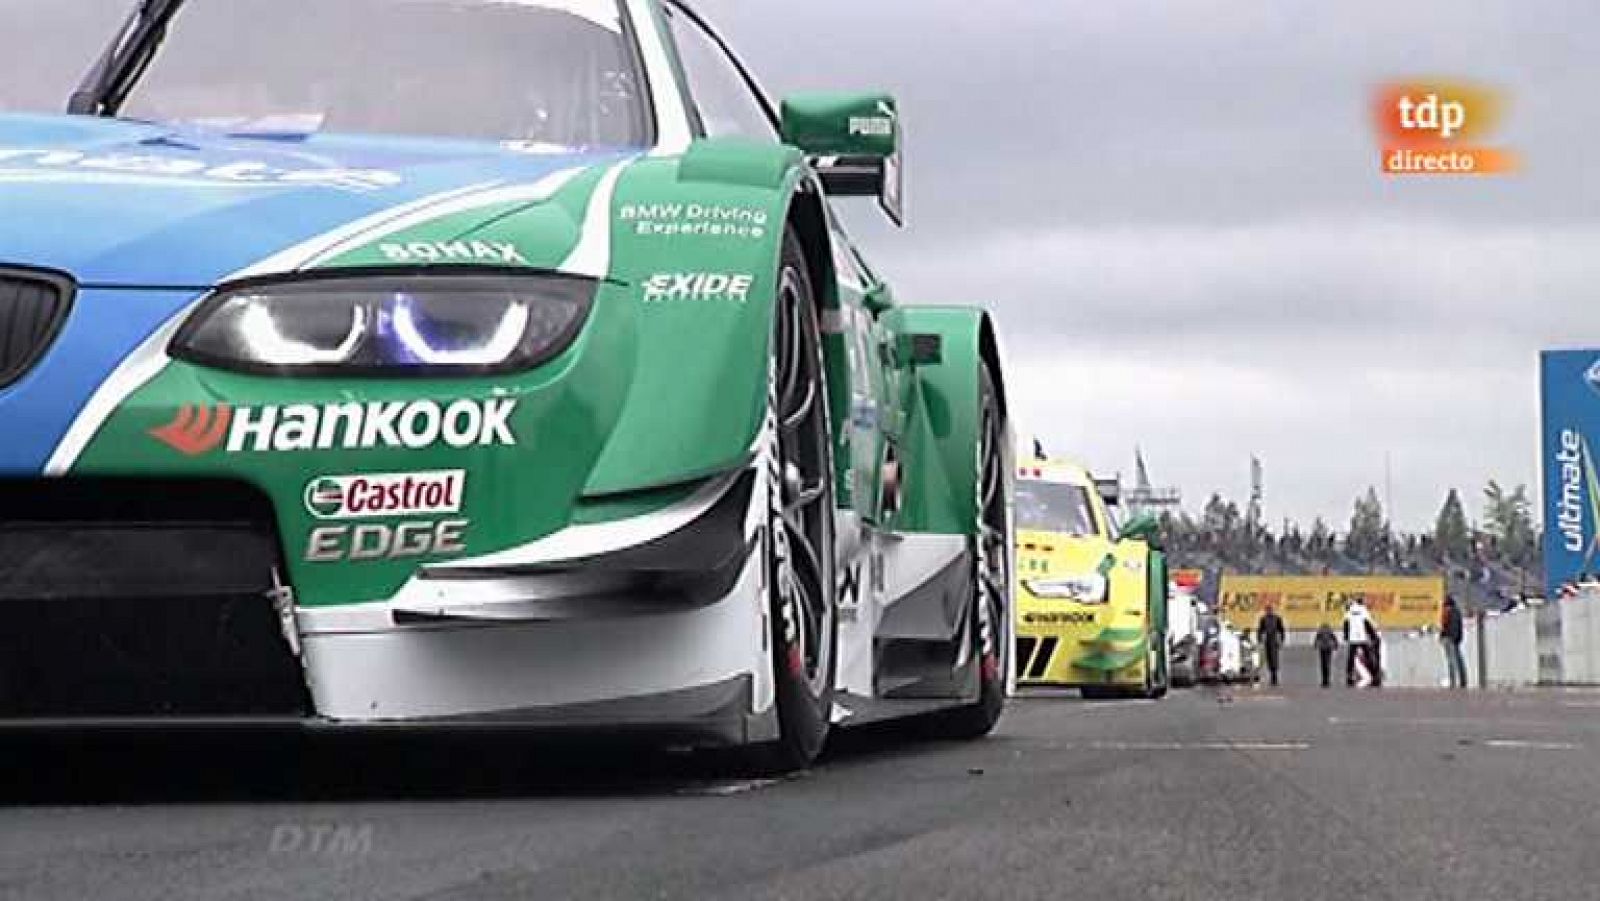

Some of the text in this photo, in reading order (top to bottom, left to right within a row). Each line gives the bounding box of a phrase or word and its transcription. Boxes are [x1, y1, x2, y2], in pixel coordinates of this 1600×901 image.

[620, 203, 767, 224] BMW Driving
[636, 220, 764, 238] Experience
[641, 272, 753, 295] EXIDE
[226, 398, 516, 451] Hankook
[346, 476, 454, 513] Castrol
[1557, 427, 1584, 551] ultimate
[305, 520, 467, 562] EDGE
